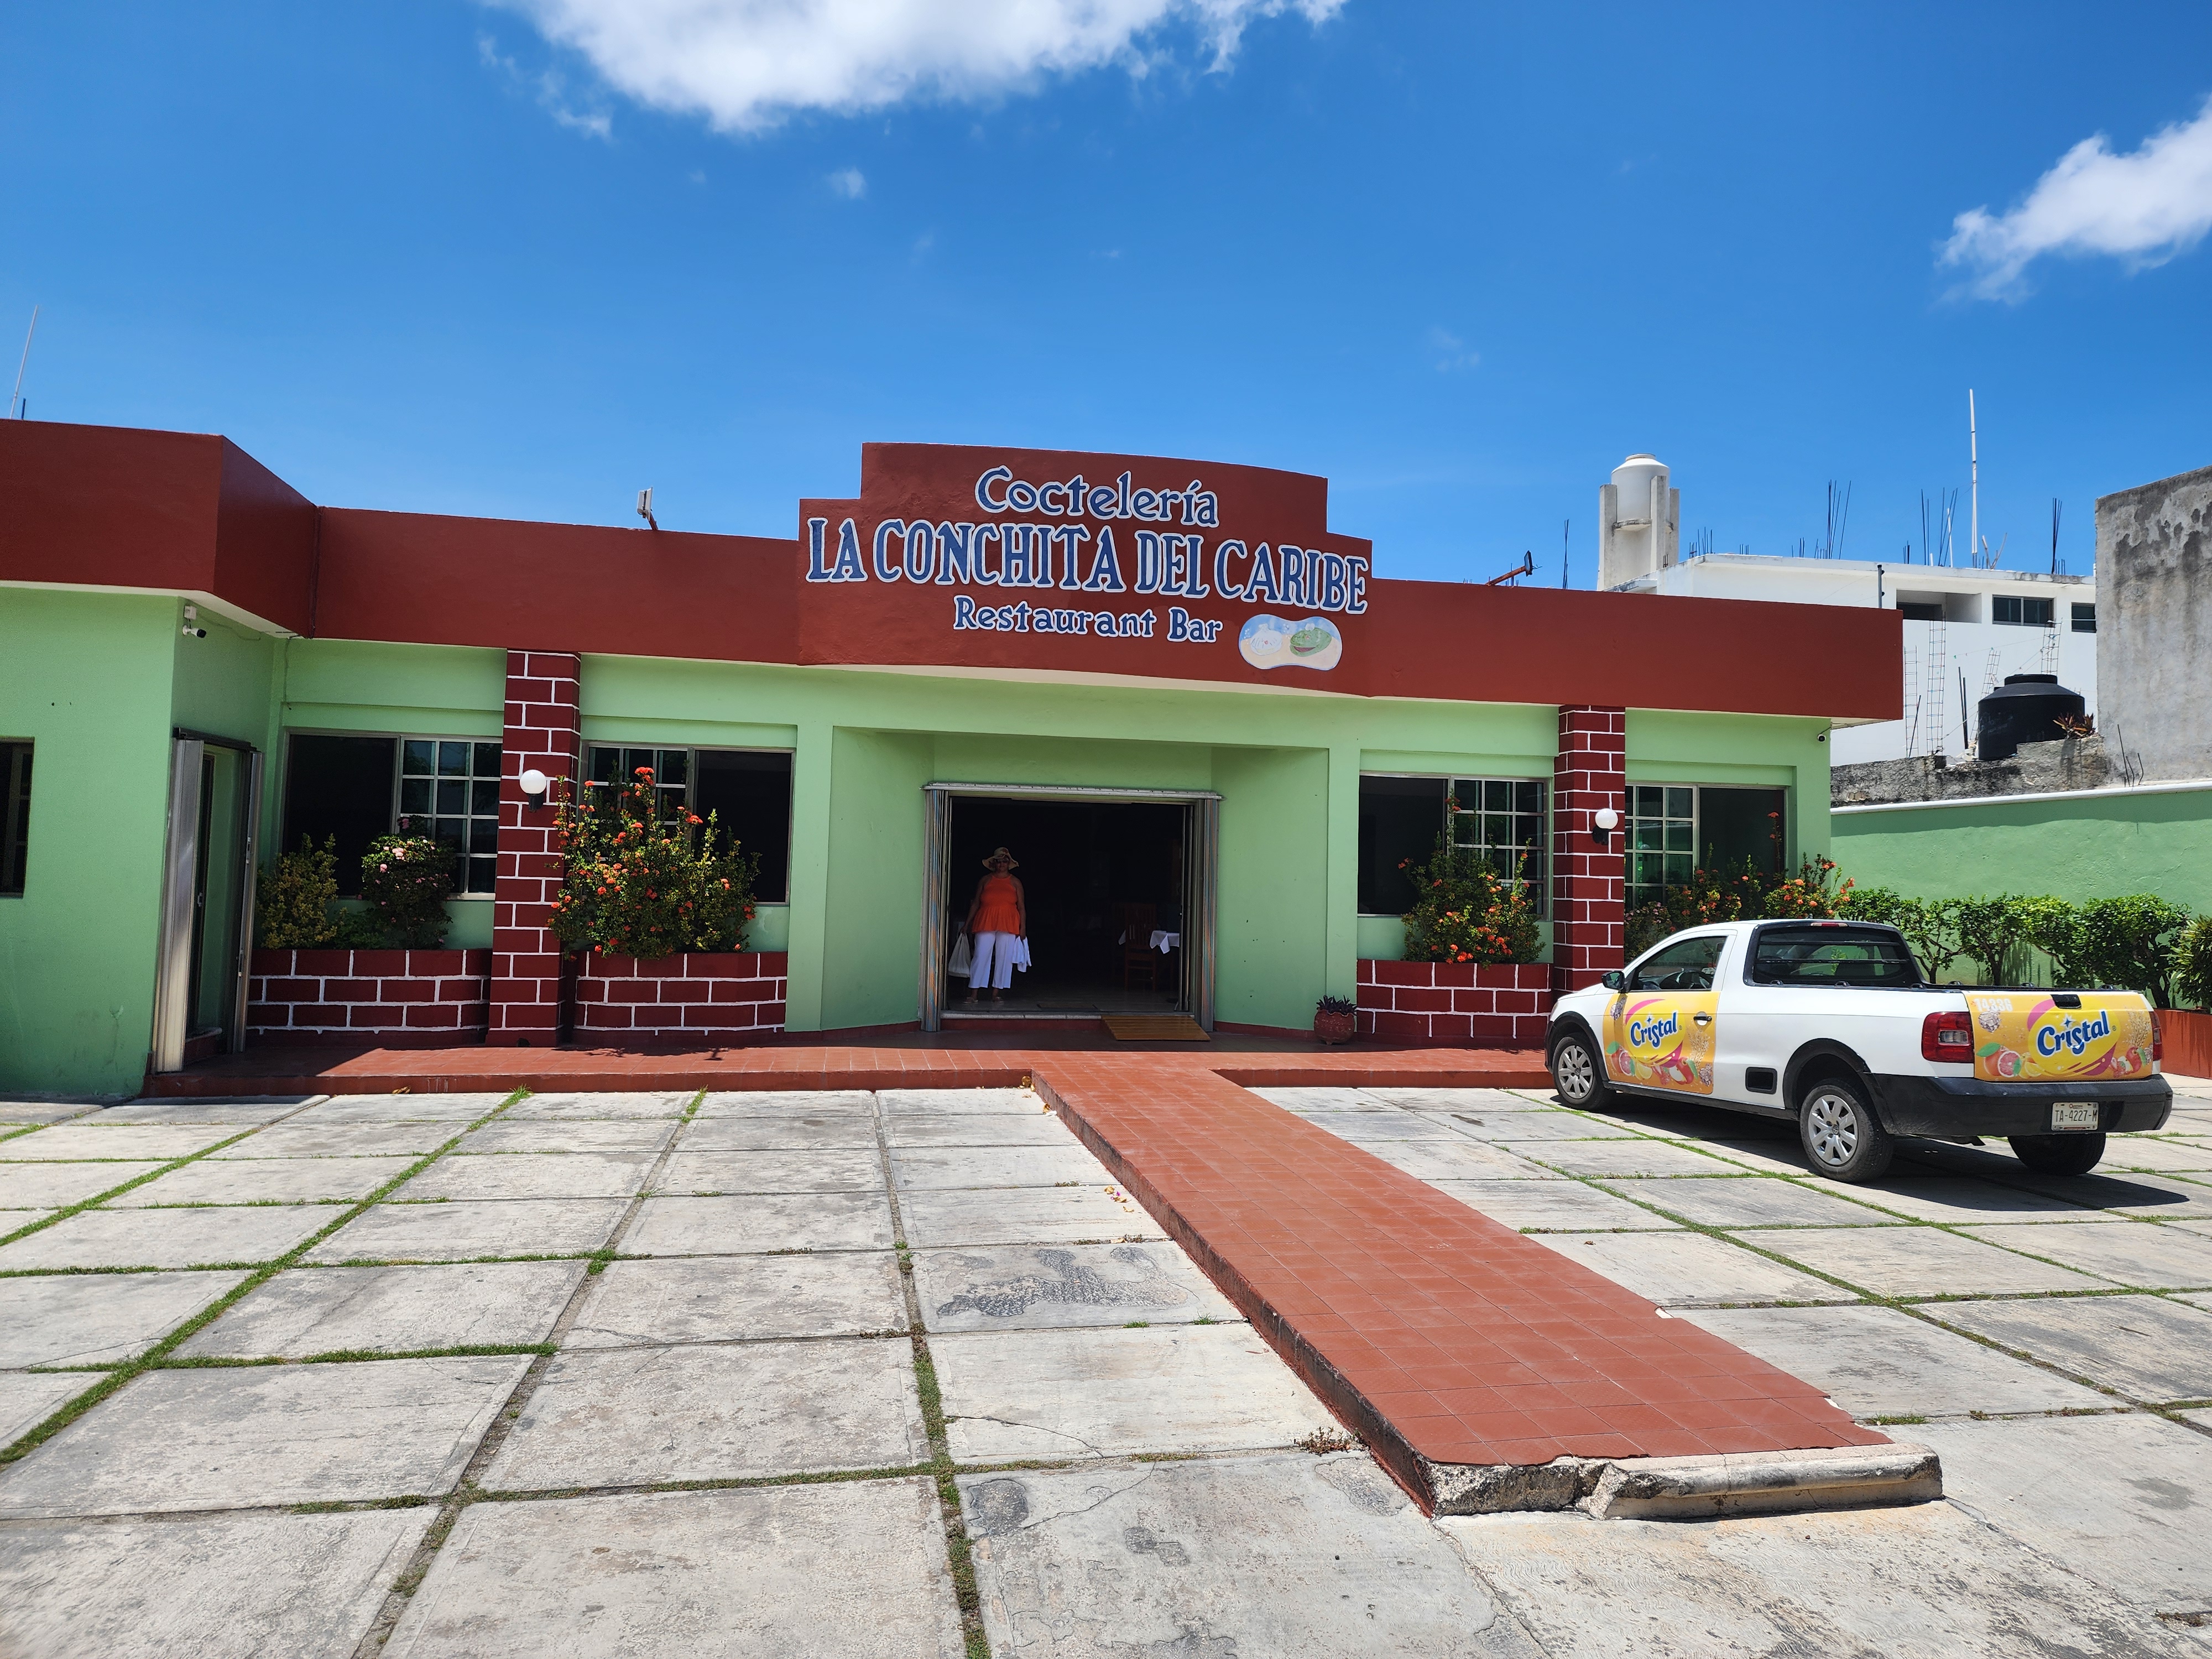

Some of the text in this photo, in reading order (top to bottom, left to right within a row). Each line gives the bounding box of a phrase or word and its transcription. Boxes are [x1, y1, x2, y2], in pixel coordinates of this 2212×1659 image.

[975, 465, 1219, 528] Coctelería
[806, 518, 1369, 614] LA CONCHITA DEL CARIBE
[953, 595, 1223, 643] Restaurant Bar
[1974, 998, 2013, 1011] 14336
[1630, 1011, 1678, 1048] Cristal
[2037, 1010, 2110, 1056] Cristal
[2055, 1109, 2098, 1122] TA-4227-M
